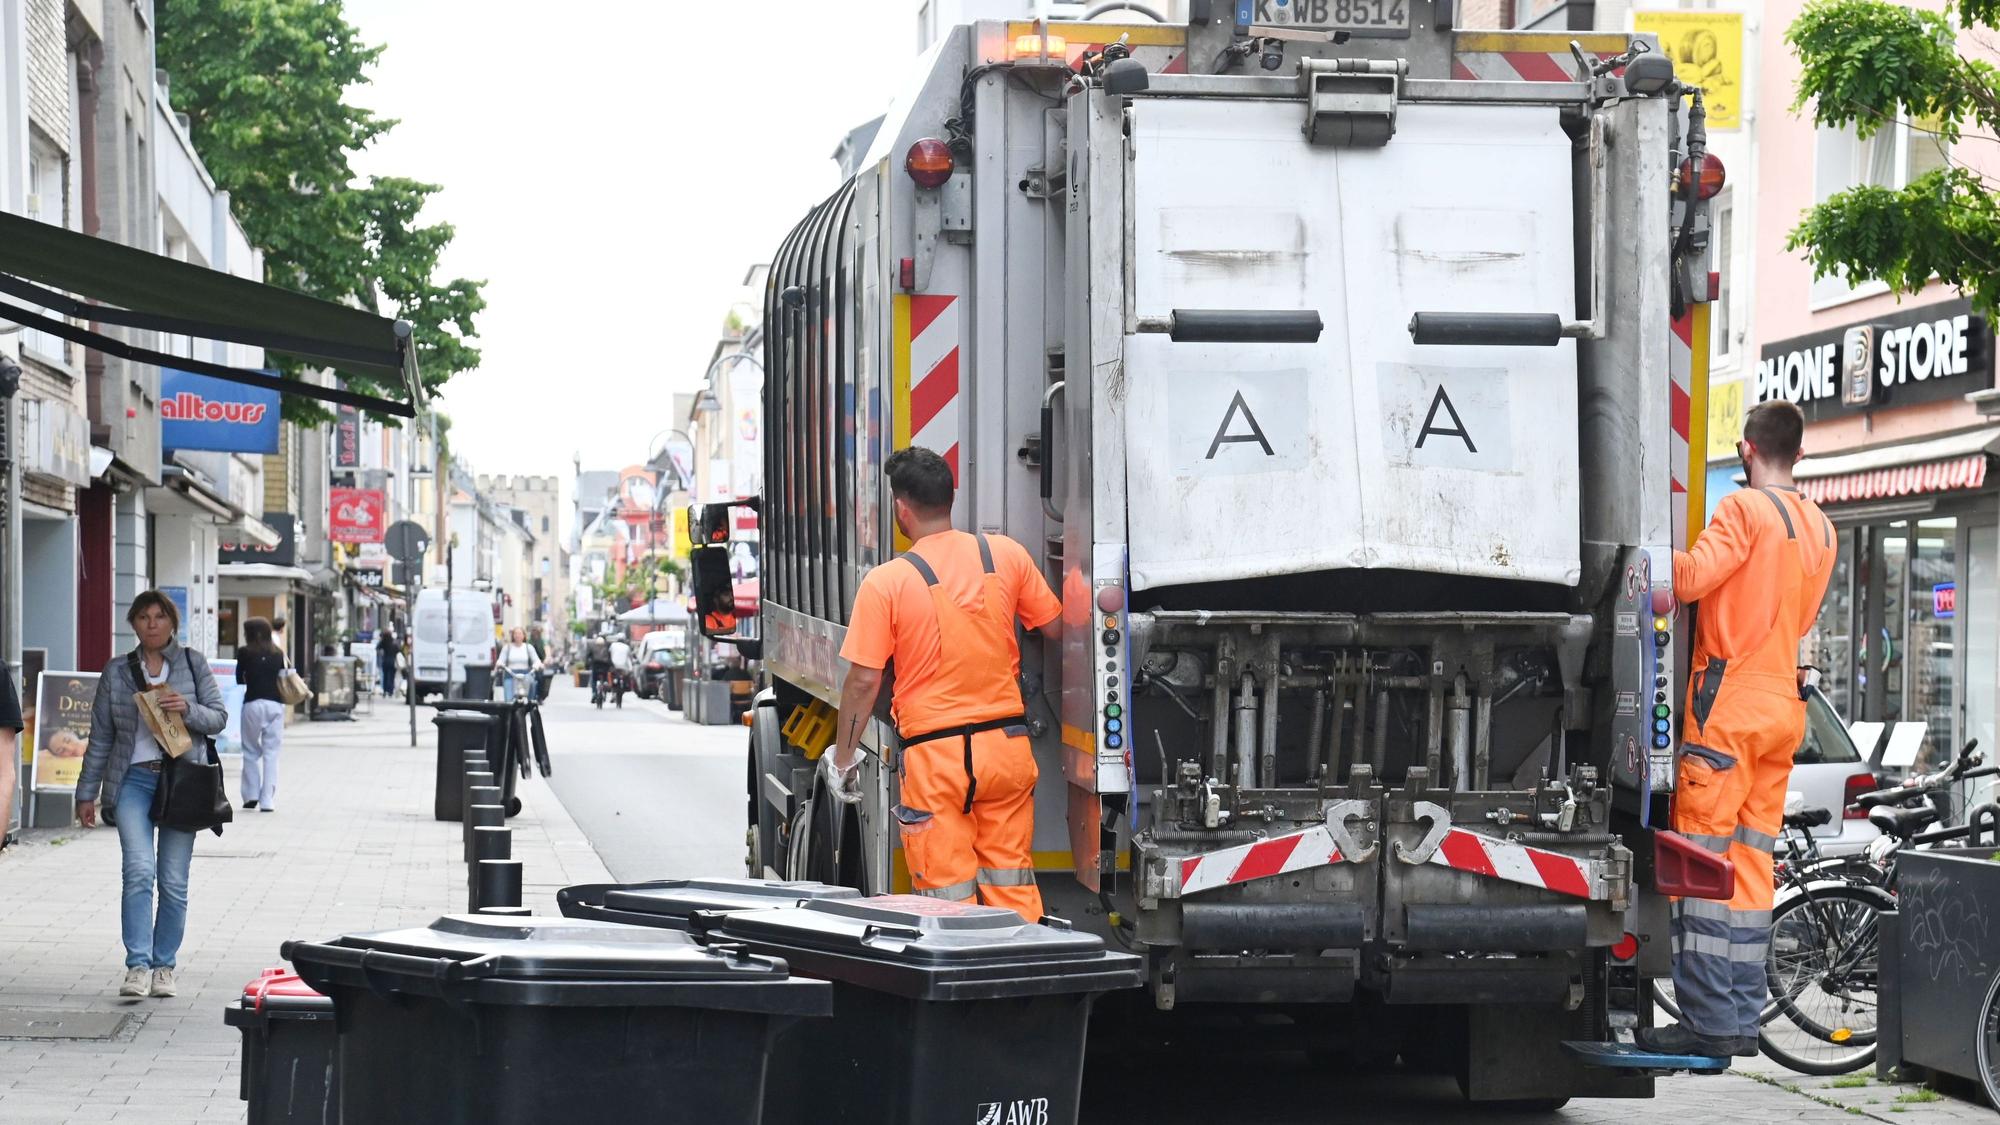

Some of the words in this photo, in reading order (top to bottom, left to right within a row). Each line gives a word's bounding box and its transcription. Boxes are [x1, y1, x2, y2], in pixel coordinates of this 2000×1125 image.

[1255, 0, 1272, 22] K
[1294, 0, 1328, 23] WB
[1335, 0, 1404, 25] 8514
[1754, 343, 1836, 404] PHONE
[1880, 314, 1969, 387] STORE
[160, 392, 266, 424] alltours
[1205, 389, 1275, 460] A
[1414, 383, 1478, 453] A
[1005, 1097, 1049, 1125] AWB
